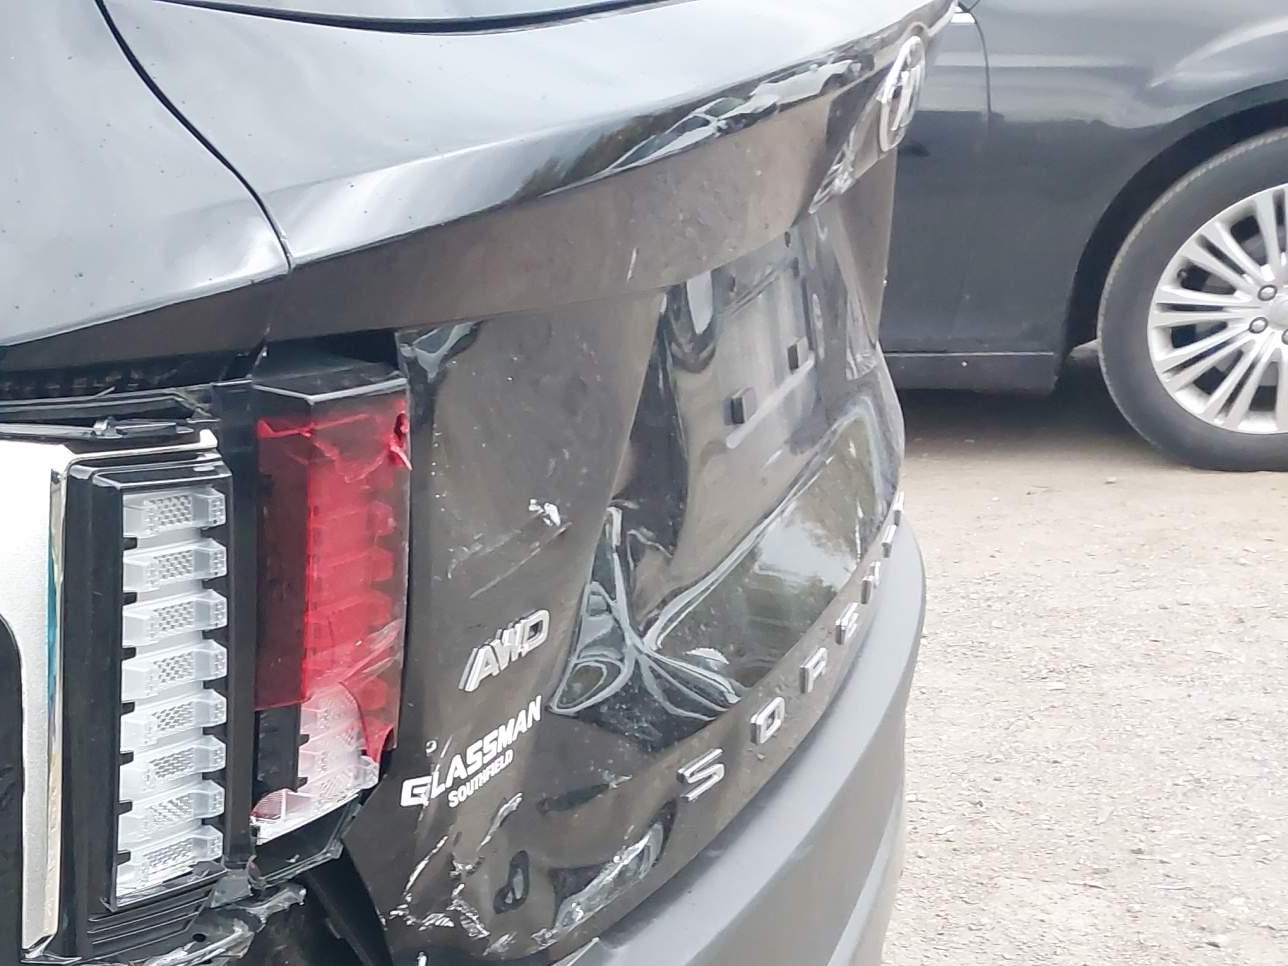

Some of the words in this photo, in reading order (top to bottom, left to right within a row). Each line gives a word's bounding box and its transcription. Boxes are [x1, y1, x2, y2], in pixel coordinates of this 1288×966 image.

[458, 609, 551, 692] AWD
[400, 695, 543, 808] GLASSMAN
[447, 749, 514, 808] SOUTHFIELD
